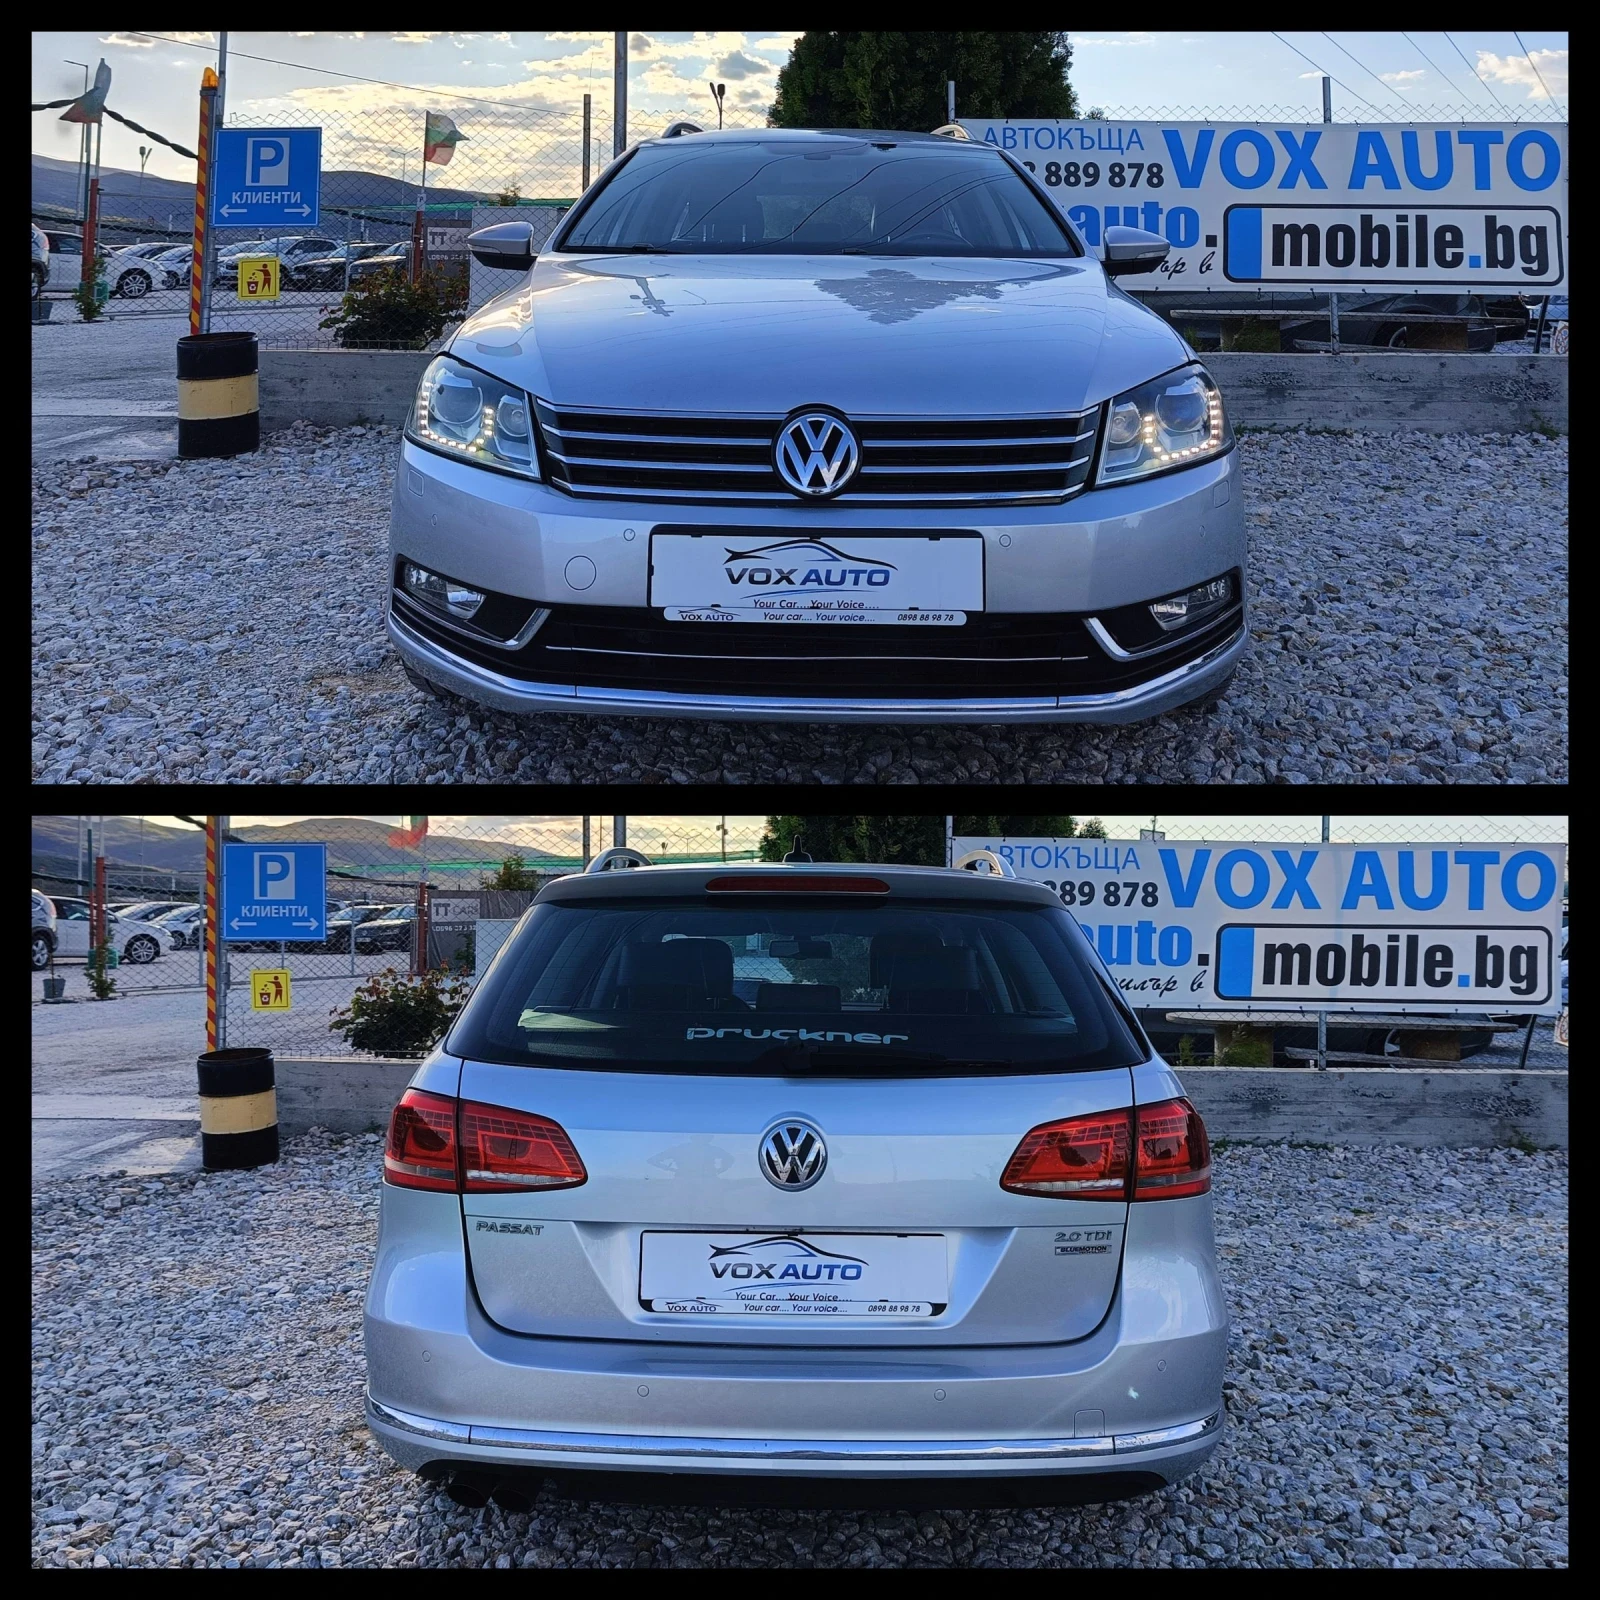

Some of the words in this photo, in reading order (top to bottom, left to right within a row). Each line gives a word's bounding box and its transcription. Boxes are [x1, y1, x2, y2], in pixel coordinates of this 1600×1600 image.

[984, 127, 1144, 155] АВТОКЪЩА
[251, 140, 284, 184] P
[1162, 129, 1328, 190] VOX
[1347, 129, 1561, 191] AUTO
[1045, 162, 1100, 187] 889
[1108, 163, 1164, 188] 878
[232, 192, 301, 204] КЛИЕНТИ
[1273, 214, 1548, 277] mobile.bg
[753, 599, 776, 609] Your
[763, 612, 786, 621] Your
[815, 613, 838, 622] Your
[259, 855, 290, 897] P
[1158, 848, 1319, 910] VOX
[1340, 850, 1556, 911] AUTO
[1103, 881, 1158, 907] 878
[241, 905, 308, 917] КЛИЕНТИ
[1262, 934, 1538, 995] mobile.bg
[476, 1220, 544, 1236] PASSAT
[1084, 1230, 1112, 1241] TDI
[735, 1292, 756, 1301] Your
[744, 1303, 765, 1312] Your
[792, 1303, 814, 1312] Your
[911, 1305, 920, 1313] 78
